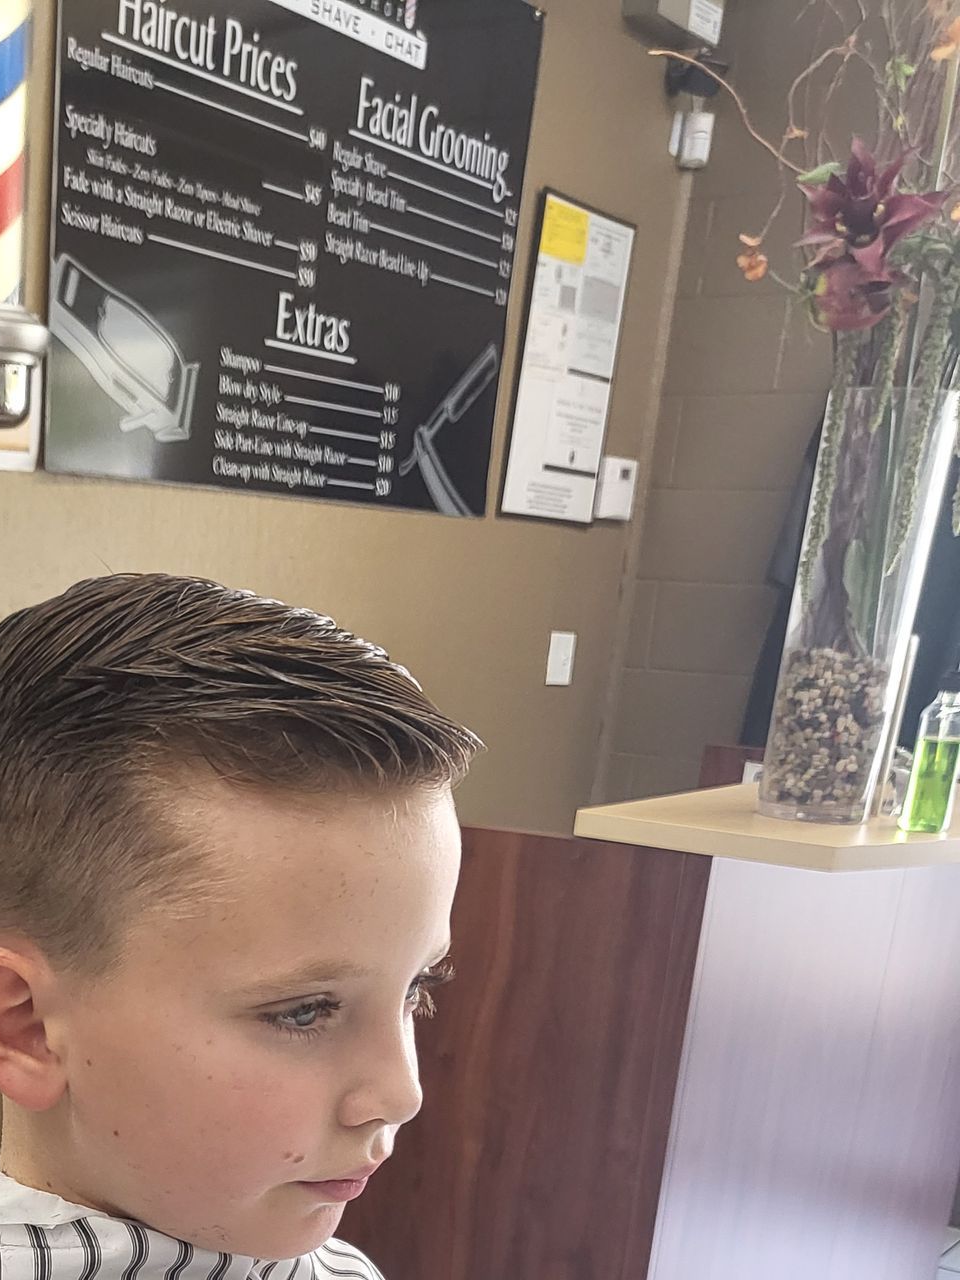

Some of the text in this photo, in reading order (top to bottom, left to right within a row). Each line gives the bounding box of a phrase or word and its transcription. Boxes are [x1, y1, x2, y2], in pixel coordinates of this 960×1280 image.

[118, 0, 298, 101] Haircut Prices
[310, 0, 421, 62] SHAVE CHAT
[67, 36, 110, 73] Regular
[111, 54, 154, 90] Haircuts
[64, 104, 113, 150] Specialty
[114, 121, 157, 157] Haircuts
[356, 76, 514, 204] Facial Grooming
[63, 165, 90, 194] Fade
[91, 178, 114, 202] with
[100, 213, 144, 245] Haircuts
[276, 291, 351, 353] Extras
[220, 346, 262, 376] Shampoo
